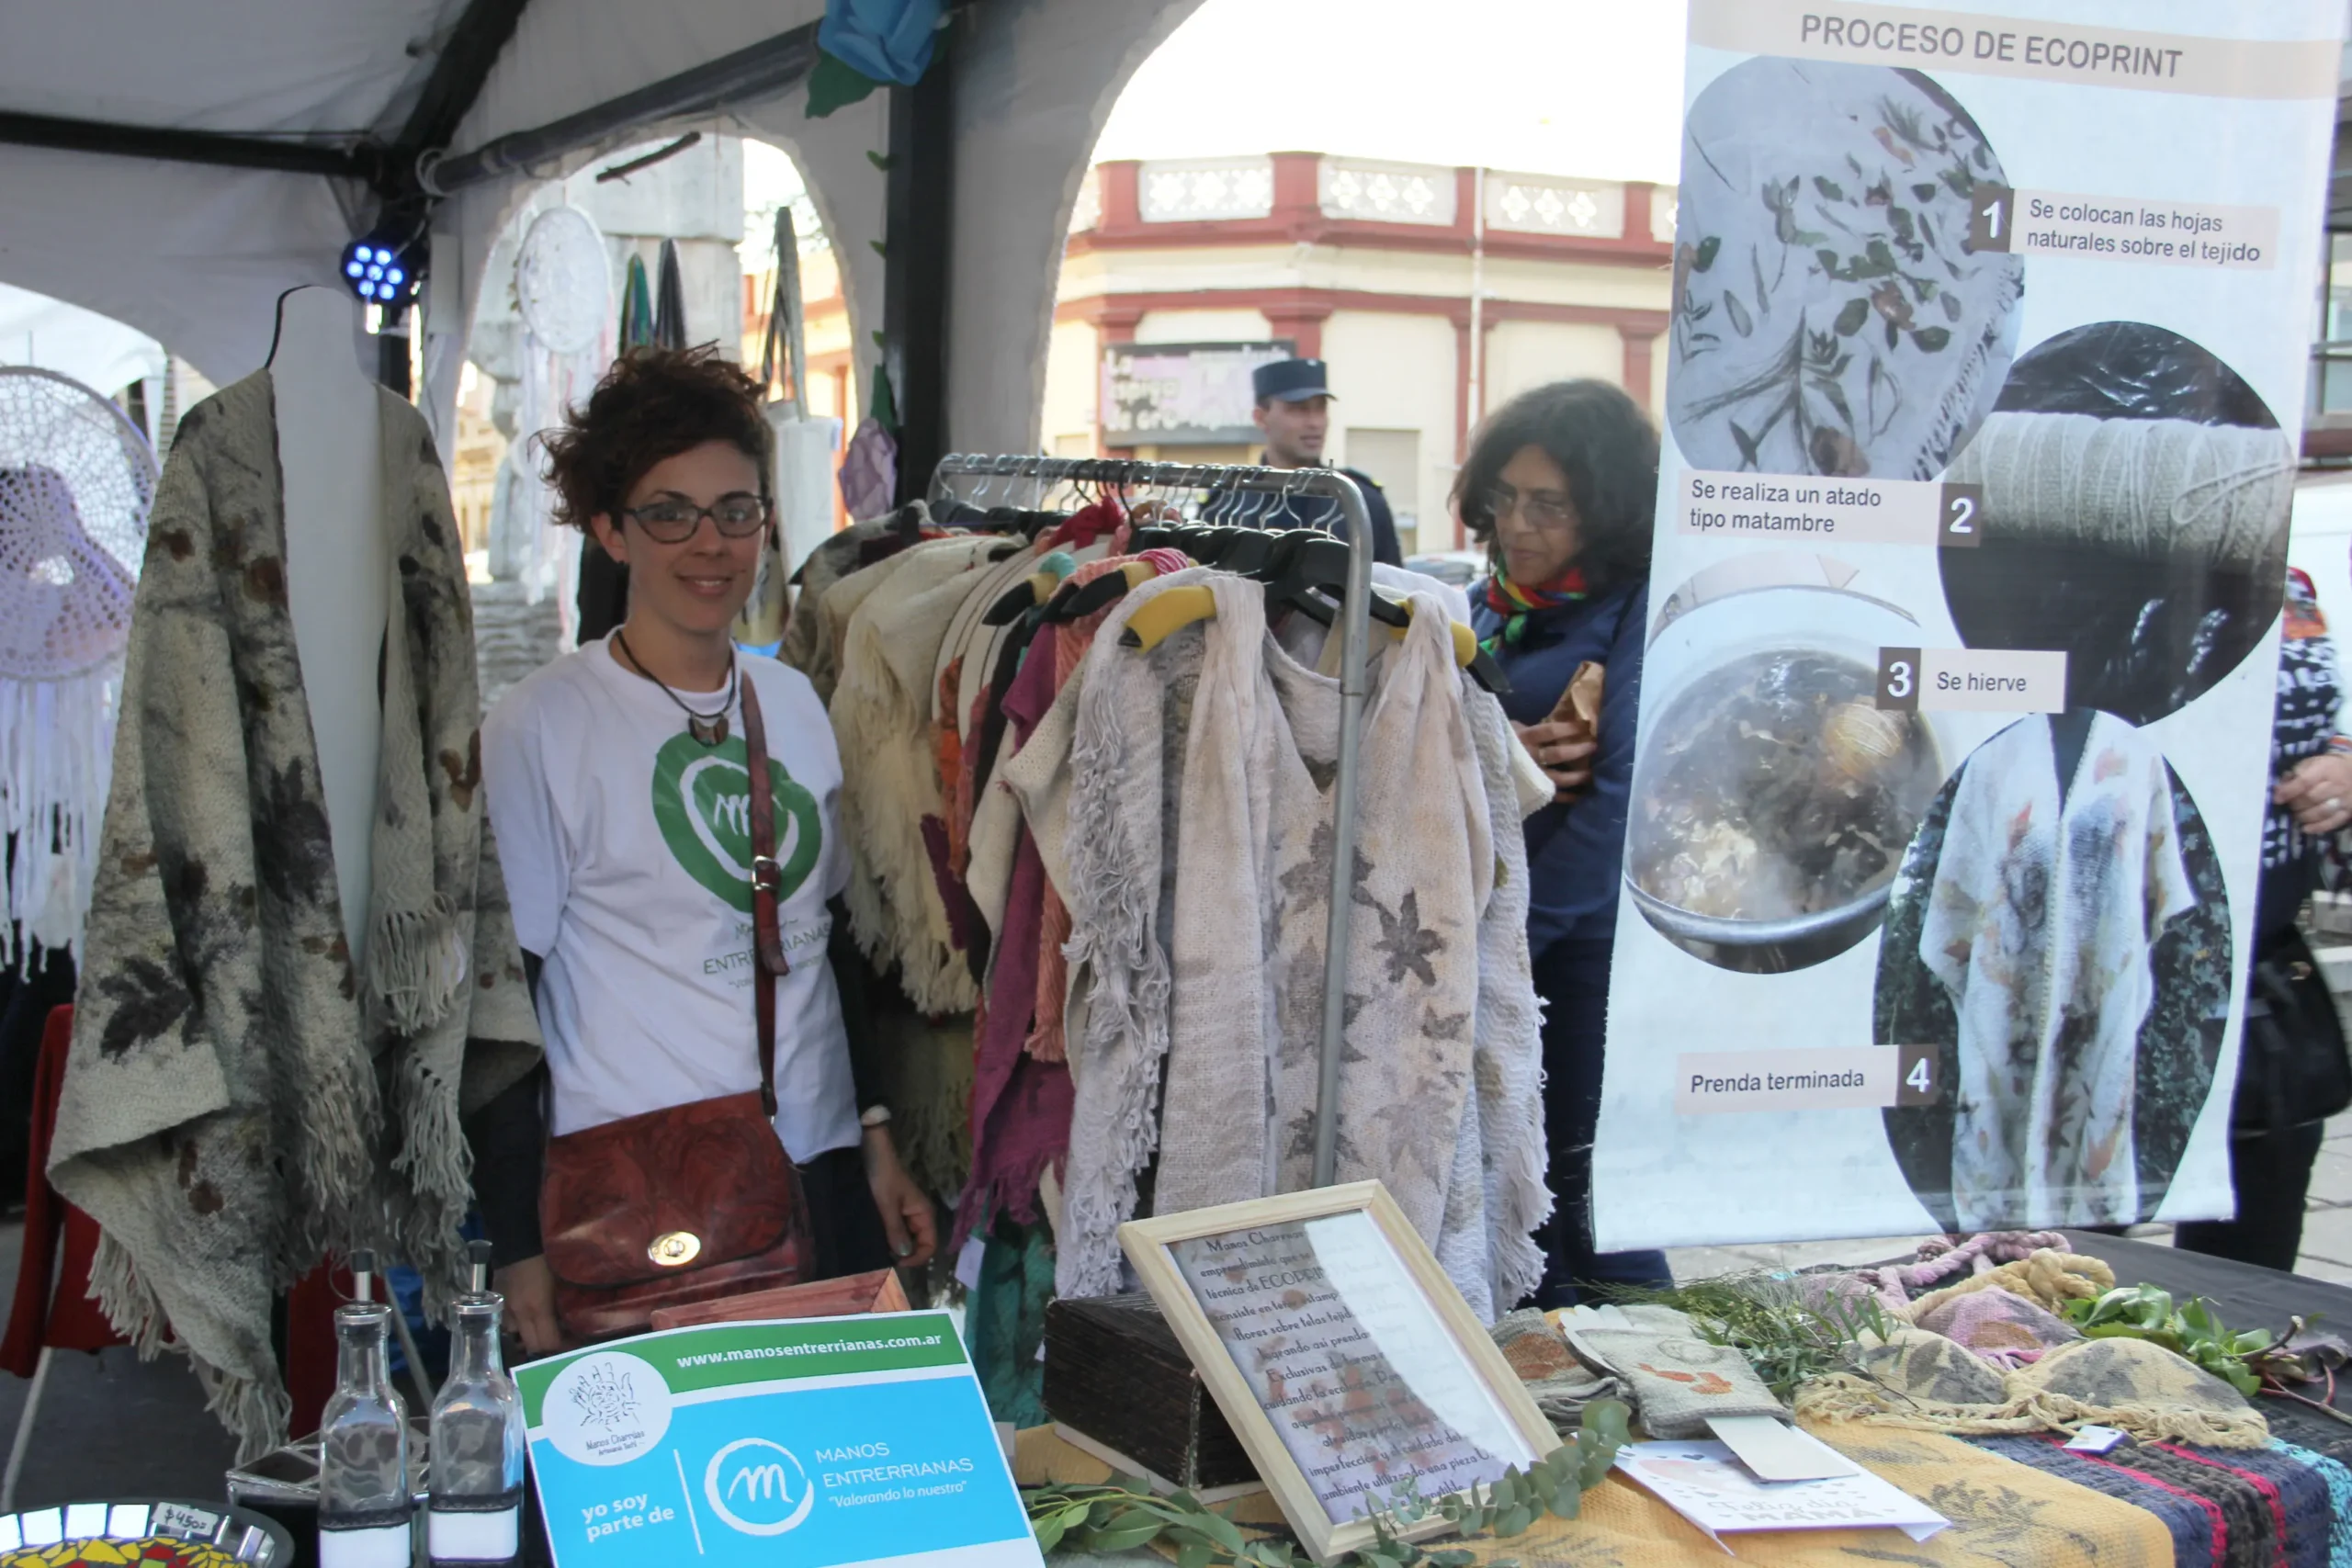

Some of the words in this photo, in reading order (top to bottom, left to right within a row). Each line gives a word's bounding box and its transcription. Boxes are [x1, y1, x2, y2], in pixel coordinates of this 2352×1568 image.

[1801, 14, 1964, 56] PROCESO
[1974, 30, 2017, 62] DE
[2025, 36, 2183, 78] ECOPRINT
[1982, 199, 2002, 239] 1
[2030, 198, 2053, 219] Se
[2060, 203, 2133, 226] colocan
[2140, 209, 2165, 228] las
[2172, 210, 2222, 235] hojas
[2028, 229, 2115, 253] naturales
[2120, 235, 2174, 257] sobre
[2179, 241, 2196, 258] el
[2201, 242, 2260, 265] tejido
[1691, 479, 1715, 499] Se
[1722, 481, 1789, 502] realiza
[1796, 489, 1819, 503] un
[1826, 487, 1882, 507] atado
[1690, 508, 1725, 531] tipo
[1732, 510, 1835, 533] matambre
[1949, 497, 1973, 534] 2
[1887, 661, 1912, 698] 3
[1937, 671, 1961, 690] Se
[1968, 672, 2027, 692] hierve
[1690, 1073, 1761, 1093] Prenda
[1767, 1069, 1864, 1090] terminada
[1905, 1057, 1930, 1093] 4
[1205, 1240, 1249, 1253] Manos
[1247, 1279, 1260, 1292] de
[1259, 1267, 1326, 1290] ECOPRIN
[1258, 1303, 1272, 1314] en
[1234, 1326, 1268, 1341] flores
[1271, 1319, 1300, 1334] sobre
[1299, 1314, 1327, 1328] telas
[676, 1334, 942, 1368] www.manosentrerrianas.com.ar
[1312, 1383, 1327, 1398] la
[816, 1442, 890, 1464] MANOS
[1380, 1451, 1390, 1462] y
[822, 1458, 975, 1487] ENTRERRIANAS
[1321, 1480, 1371, 1502] ambiente
[1427, 1463, 1448, 1474] una
[1449, 1456, 1479, 1472] pieza
[903, 1486, 916, 1500] lo
[581, 1504, 608, 1525] yo
[613, 1494, 648, 1513] soy
[586, 1514, 644, 1543] parte
[648, 1506, 675, 1523] de
